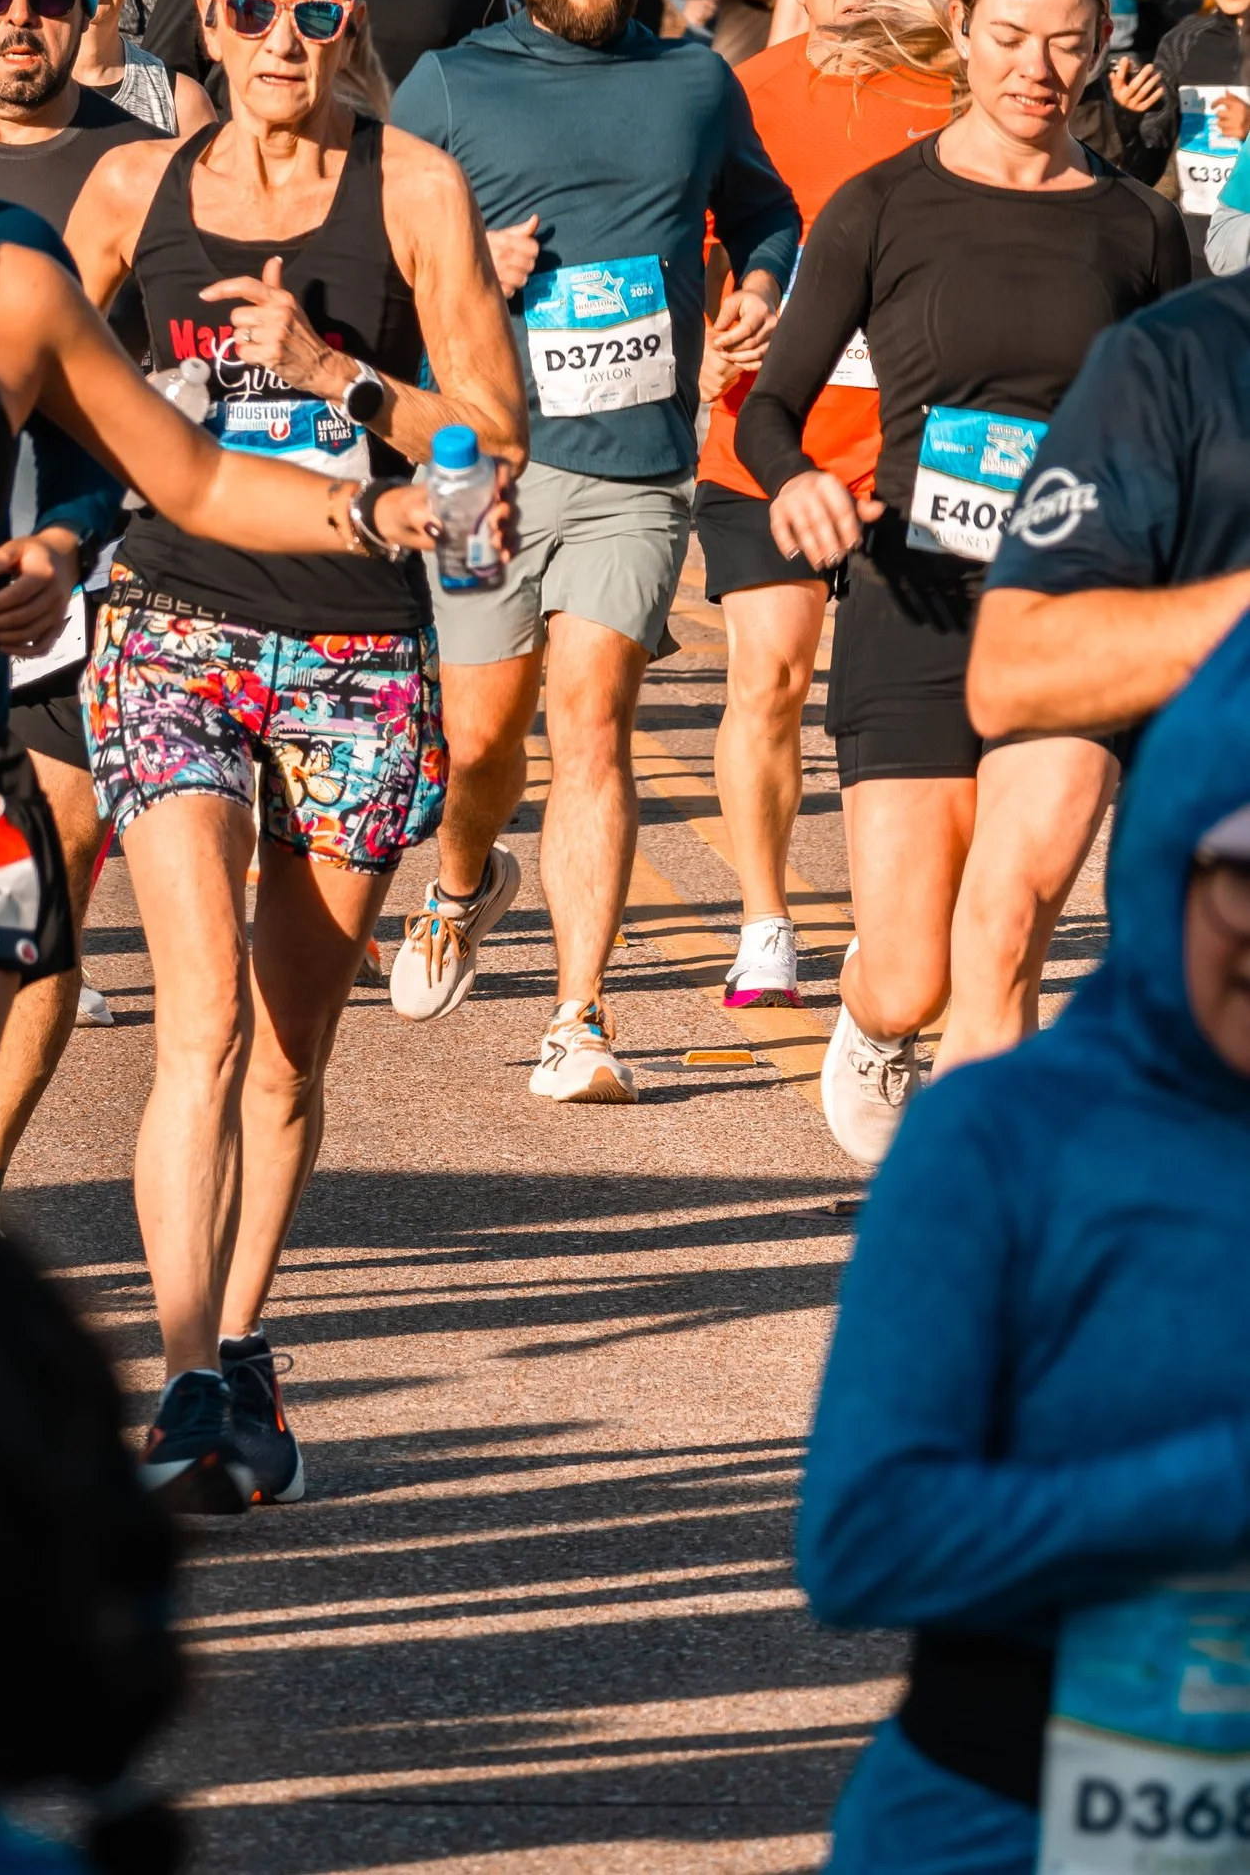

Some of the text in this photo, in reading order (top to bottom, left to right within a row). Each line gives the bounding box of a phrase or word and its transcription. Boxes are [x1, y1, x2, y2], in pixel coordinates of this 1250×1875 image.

[630, 286, 654, 298] 2026
[544, 333, 661, 372] D37239
[583, 367, 632, 384] TAYLOR
[226, 404, 290, 420] HOUSTON
[318, 428, 352, 442] 21 YEARS
[110, 585, 227, 620] SPIBEL
